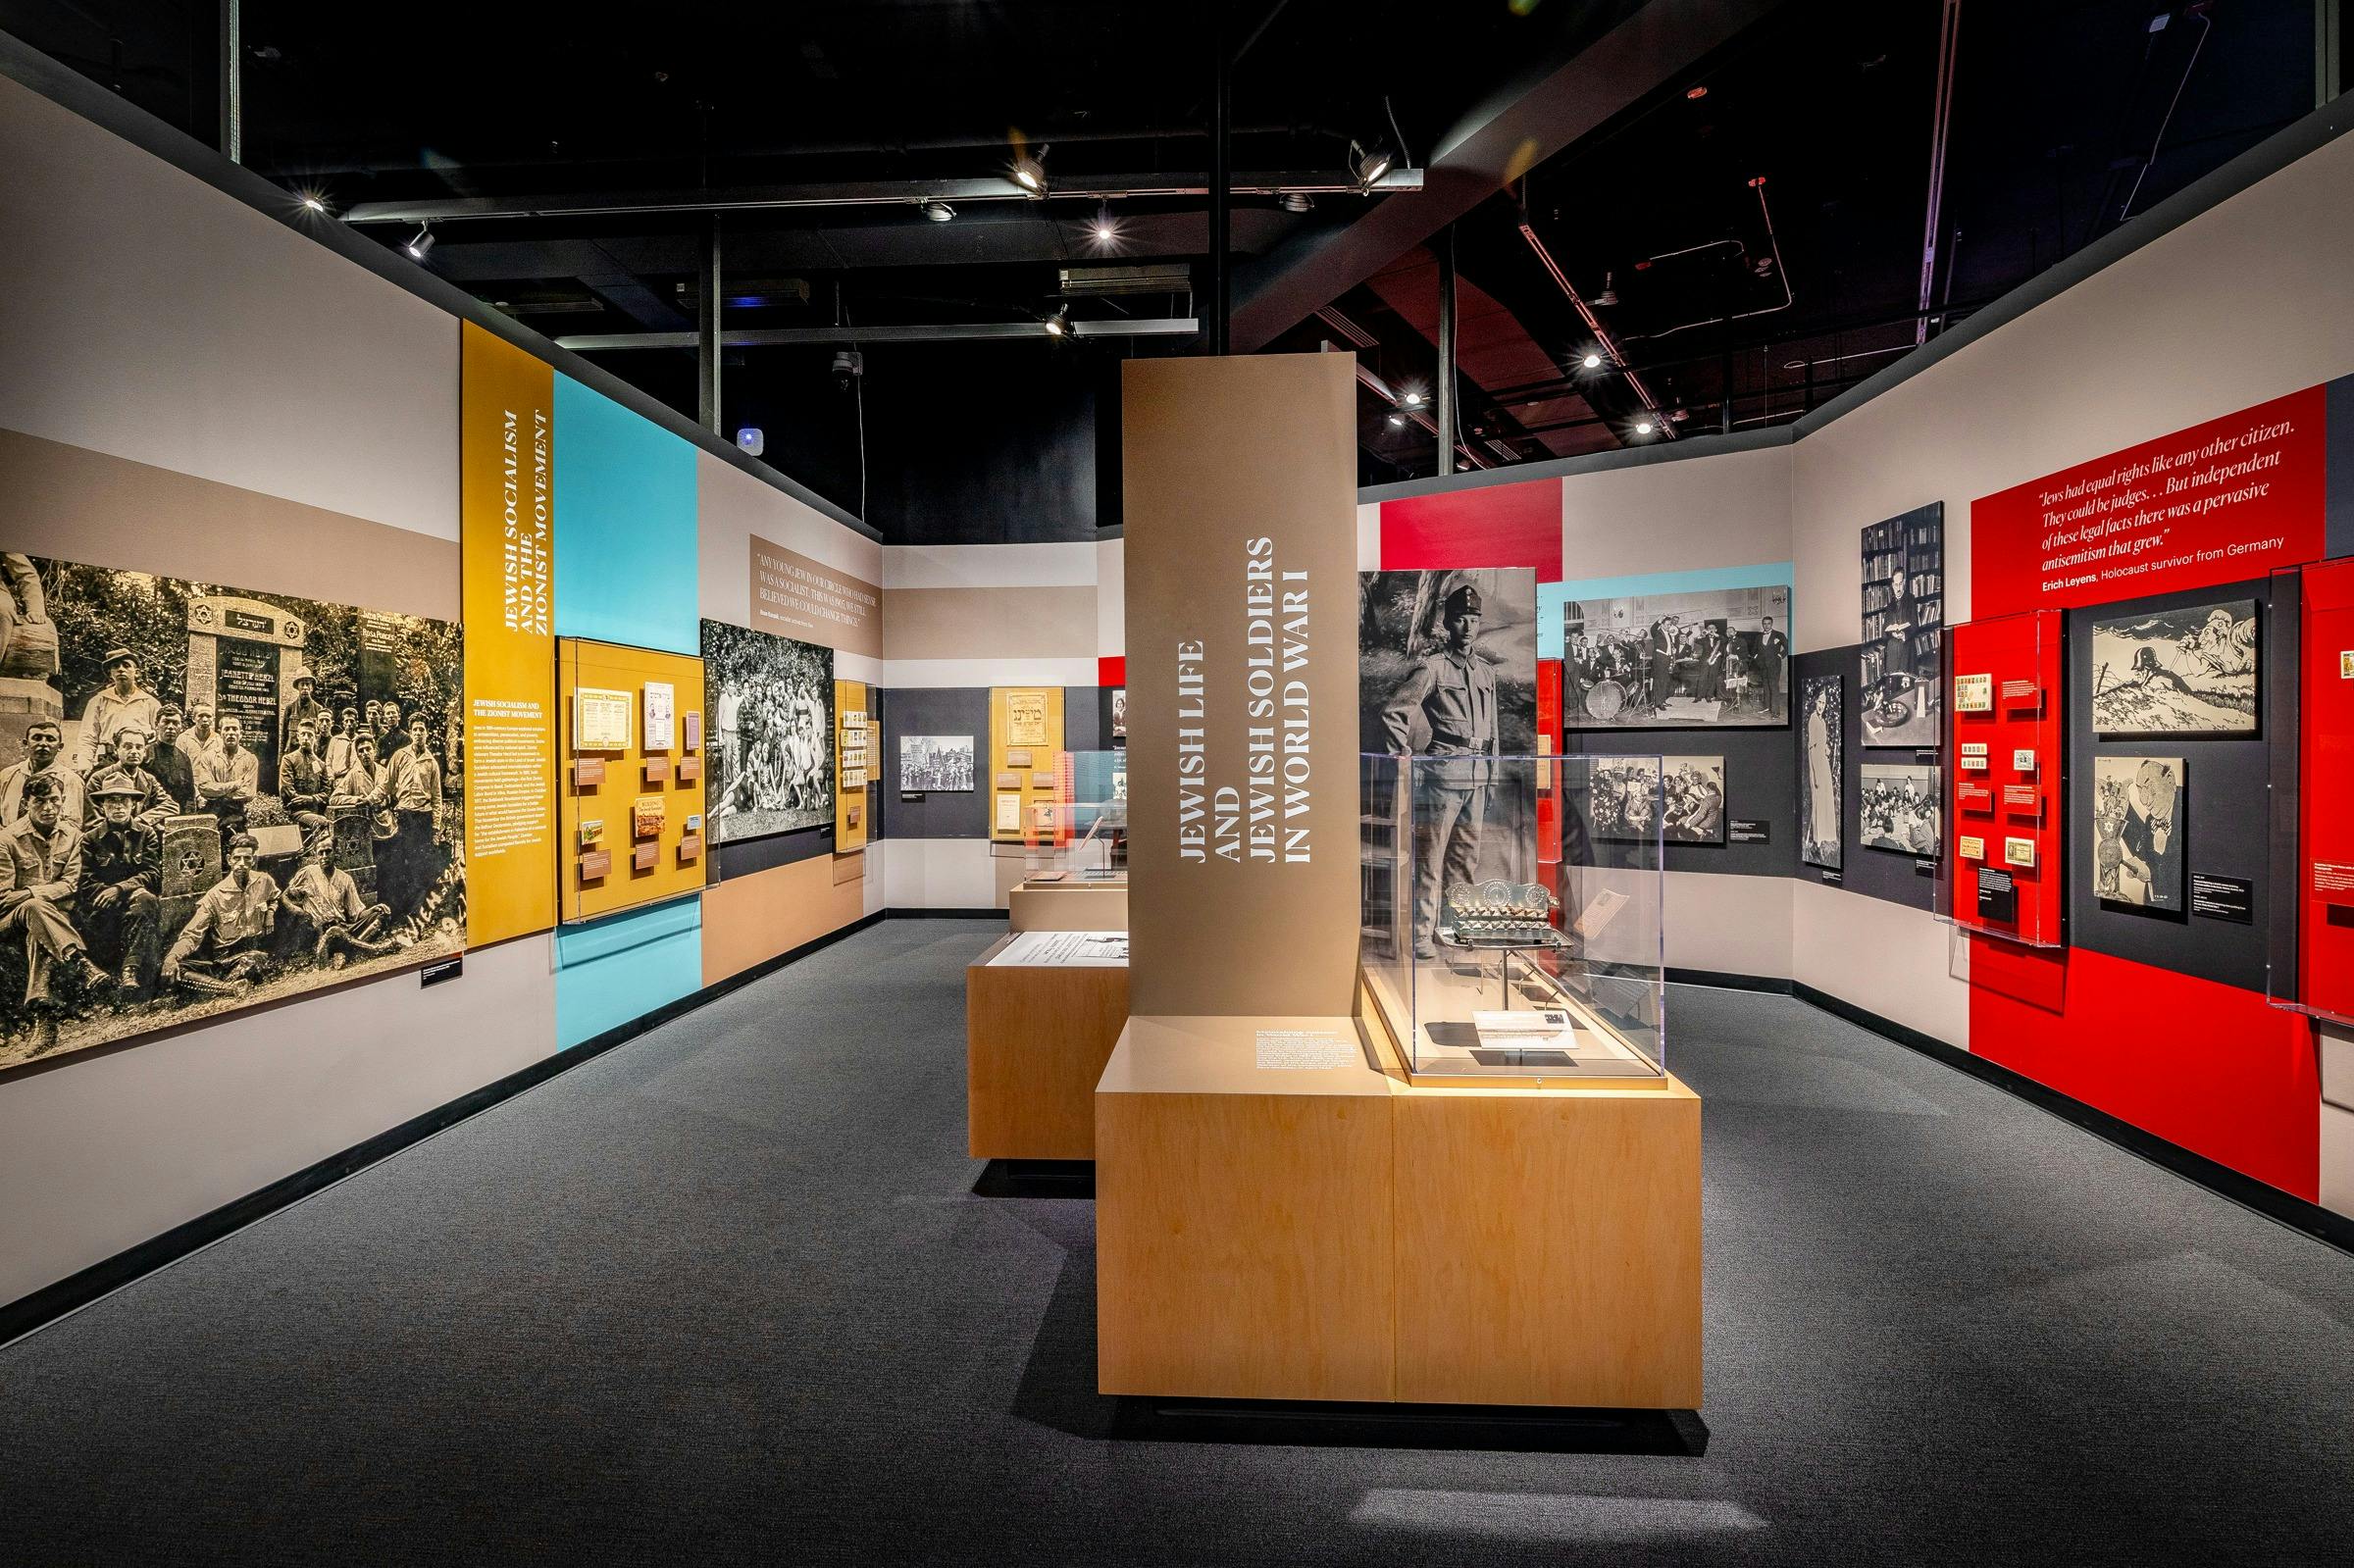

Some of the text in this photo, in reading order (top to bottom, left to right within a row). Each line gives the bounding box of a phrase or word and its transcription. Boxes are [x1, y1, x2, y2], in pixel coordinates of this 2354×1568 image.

[2043, 511, 2067, 528] They
[2068, 500, 2095, 522] could
[2096, 496, 2109, 513] be
[2166, 477, 2188, 494] But
[2191, 450, 2280, 488] independent
[2065, 481, 2085, 500] had
[2086, 470, 2116, 495] equal
[2117, 464, 2149, 485] rights
[2152, 455, 2174, 473] like
[2175, 449, 2199, 468] any
[2201, 436, 2238, 459] other
[2240, 421, 2294, 447] citizen.
[504, 410, 518, 632] JEWISH SOCIALISM
[535, 409, 547, 635] ZIONIST MOVEMENT
[2042, 481, 2270, 551] of these legal facts there was a pervasive
[2042, 542, 2106, 572] antisemitism
[2108, 537, 2131, 557] that
[520, 532, 533, 634] AND THE
[760, 587, 789, 606] BELIEVED
[799, 599, 820, 616] COULD
[2042, 535, 2284, 591] Erich Leyens, Holocaust survivor from Germany
[227, 693, 257, 704] THEODOR
[473, 699, 495, 708] JEWISH
[496, 700, 527, 709] SOCIALISM
[486, 709, 510, 718] ZIONIST
[511, 710, 542, 719] MOVEMENT
[1247, 536, 1276, 864] JEWISH SOLDIERS
[1282, 571, 1310, 863] IN WORLD WAR I
[1178, 640, 1205, 864] JEWISH LIFE
[1214, 785, 1241, 864] AND
